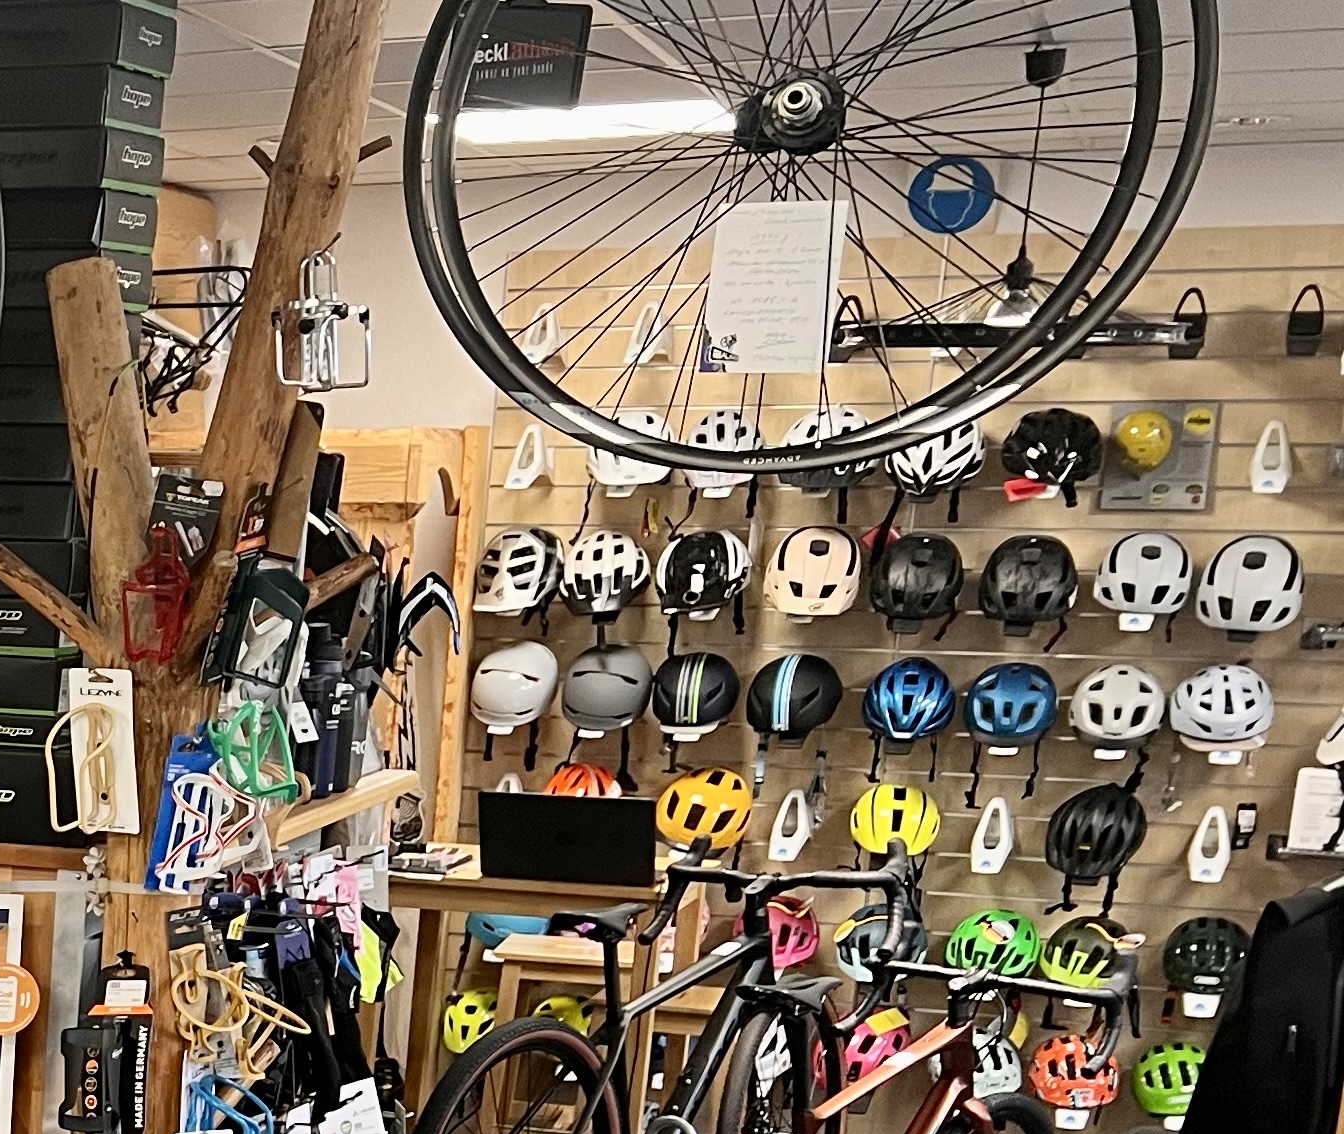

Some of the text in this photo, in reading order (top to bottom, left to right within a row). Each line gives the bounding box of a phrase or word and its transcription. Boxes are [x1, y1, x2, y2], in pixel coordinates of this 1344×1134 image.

[474, 43, 509, 65] eckl
[122, 85, 152, 108] hope
[122, 146, 152, 169] hope
[118, 207, 147, 230] hope
[79, 686, 125, 698] LEZYNE
[134, 1024, 150, 1129] MADE IN GERMANY
